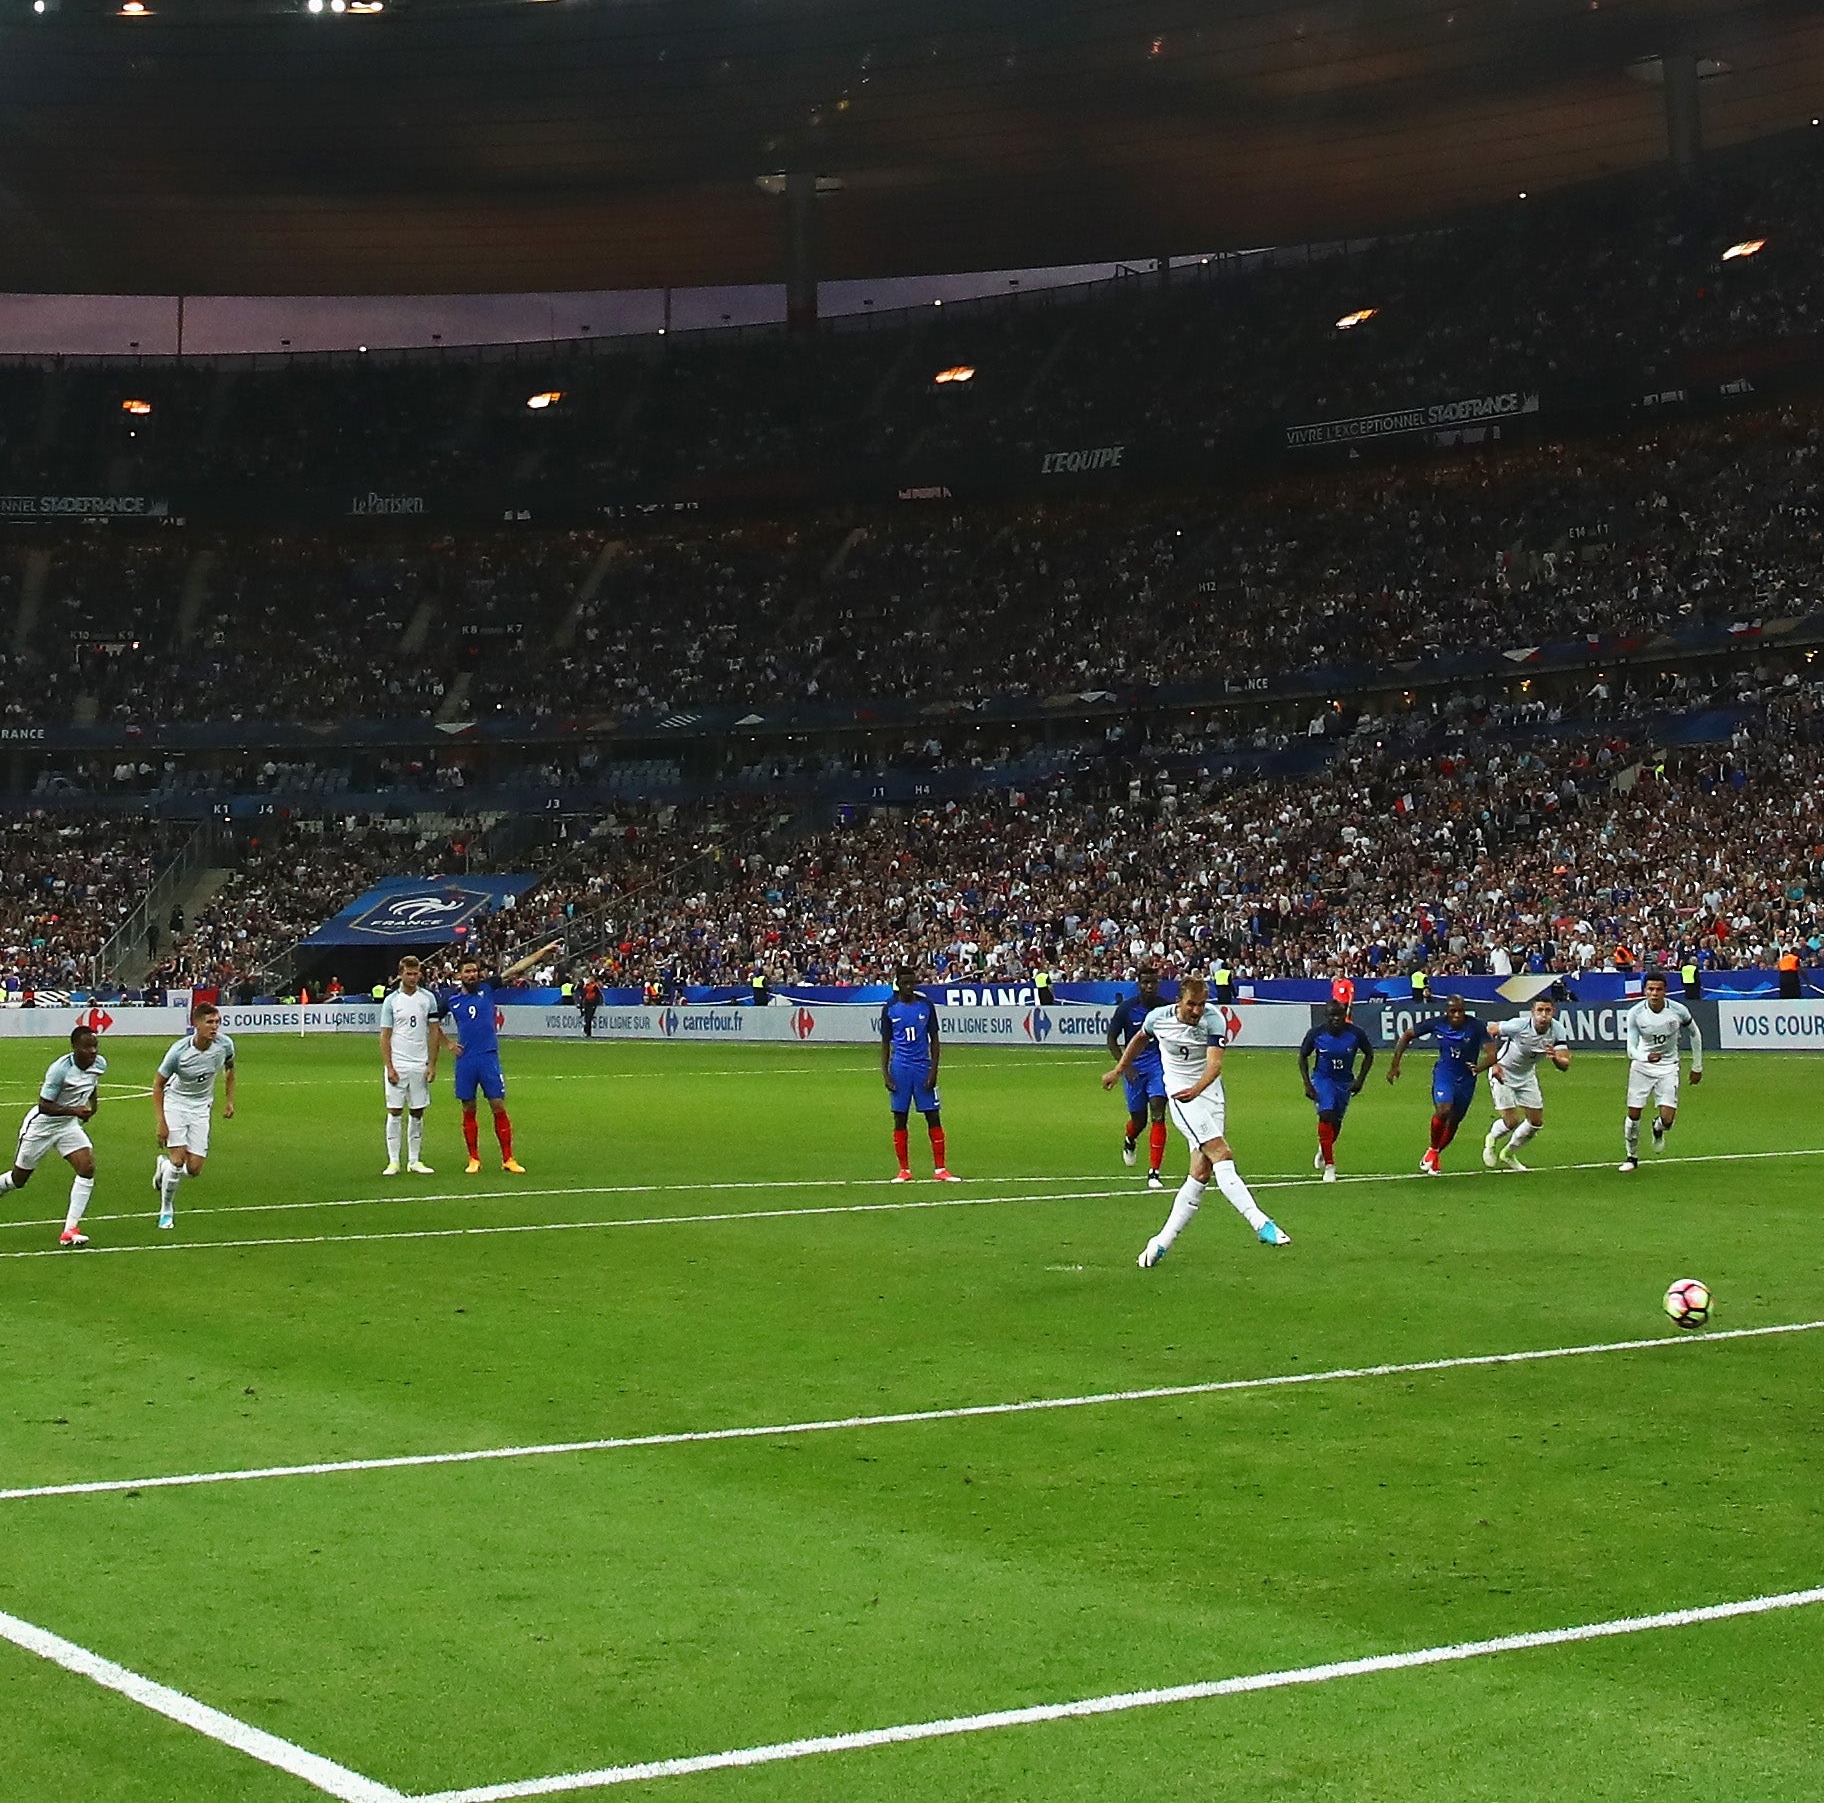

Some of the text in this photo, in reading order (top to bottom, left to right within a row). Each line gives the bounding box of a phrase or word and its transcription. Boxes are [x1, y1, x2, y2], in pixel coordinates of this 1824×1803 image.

[1286, 393, 1518, 445] VIVRE L'EXCEPTIONNEL STADEFRANCE
[40, 497, 145, 512] STADEFRANCE
[367, 493, 424, 513] Parisien
[506, 623, 523, 634] K7
[871, 786, 886, 798] J1
[213, 804, 275, 816] K1 J4
[545, 799, 561, 811] J3
[946, 988, 1040, 1005] FRANC
[234, 1013, 299, 1026] COURSES
[304, 1013, 323, 1026] EN
[358, 1012, 376, 1025] SUR
[468, 1006, 477, 1019] 9
[410, 1016, 417, 1028] 8
[612, 1016, 633, 1029] LIGNE
[635, 1016, 651, 1029] SUR
[683, 1012, 743, 1031] carrefour.fr
[942, 1019, 955, 1032] EN
[958, 1019, 987, 1032] LIGNE
[992, 1019, 1012, 1032] SUR
[1733, 1016, 1769, 1035] VOS
[905, 1027, 915, 1041] 11
[1653, 1034, 1666, 1044] 10
[1179, 1047, 1190, 1060] 9
[1331, 1059, 1343, 1070] 13
